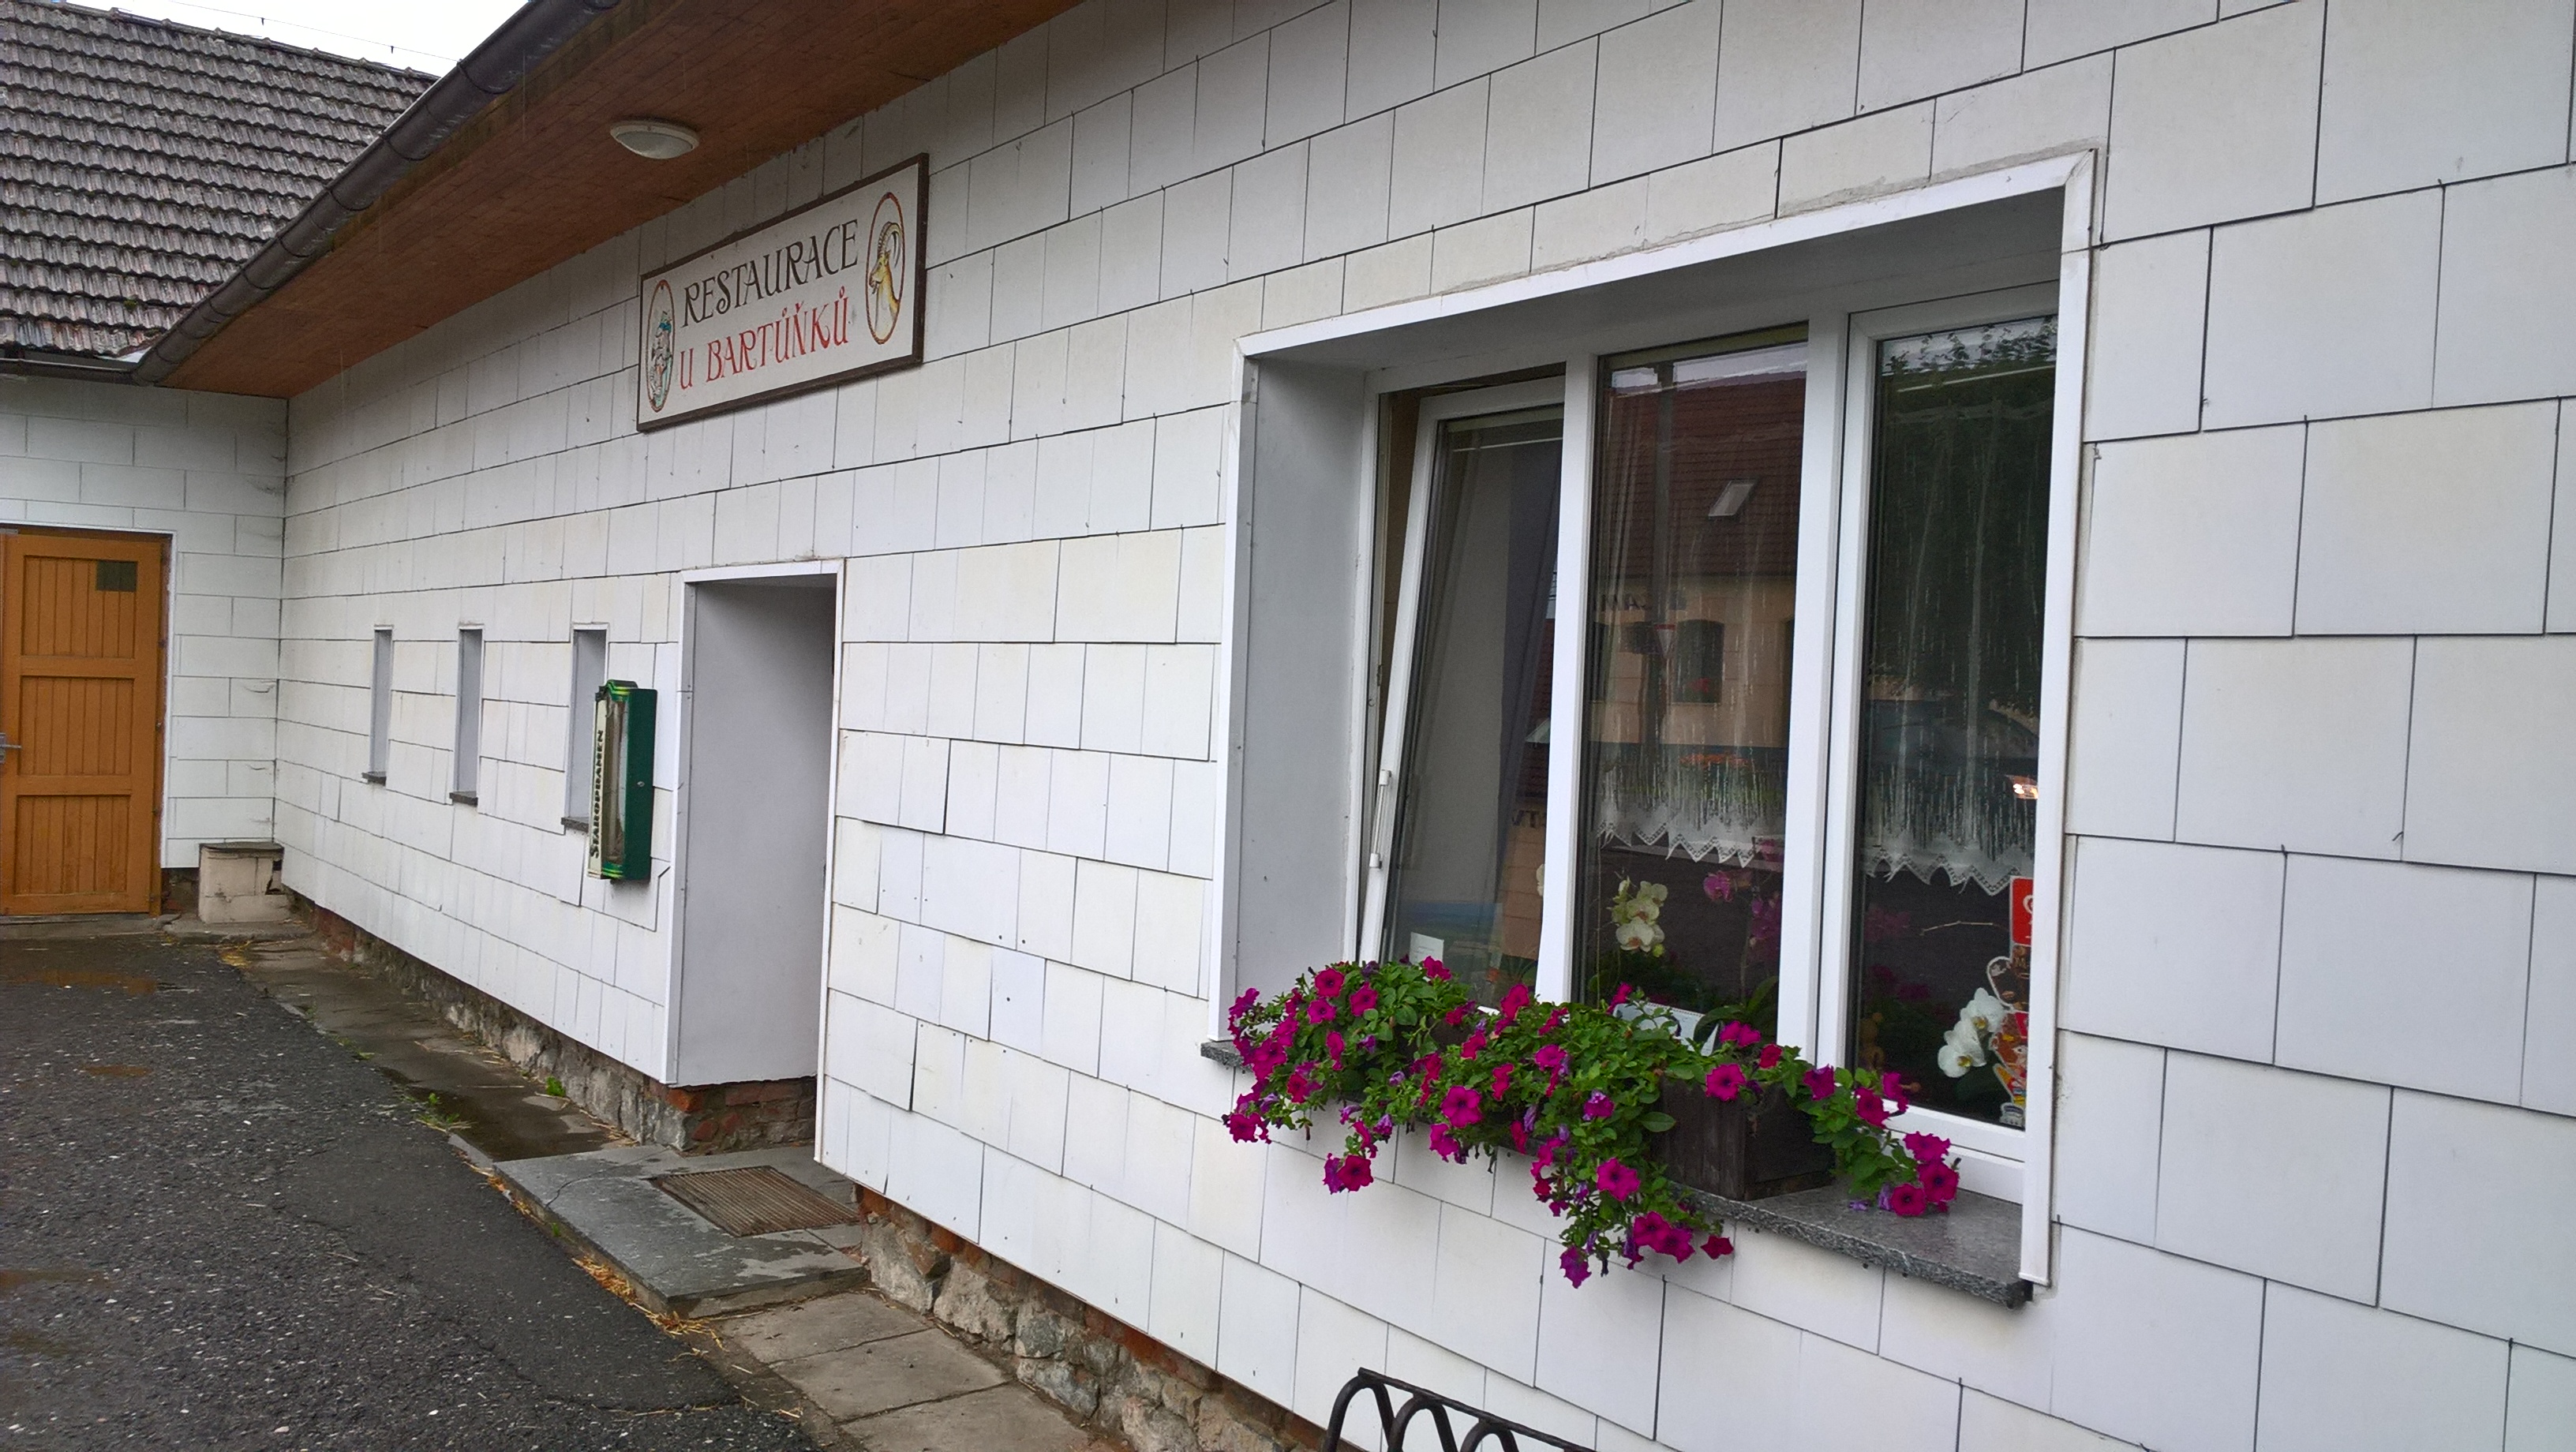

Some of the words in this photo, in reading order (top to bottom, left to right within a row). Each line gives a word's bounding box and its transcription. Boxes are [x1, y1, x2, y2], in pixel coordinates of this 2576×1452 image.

[682, 219, 858, 327] RESTAURACE
[680, 348, 694, 390] U
[706, 286, 849, 382] BARTŮŇKŮ
